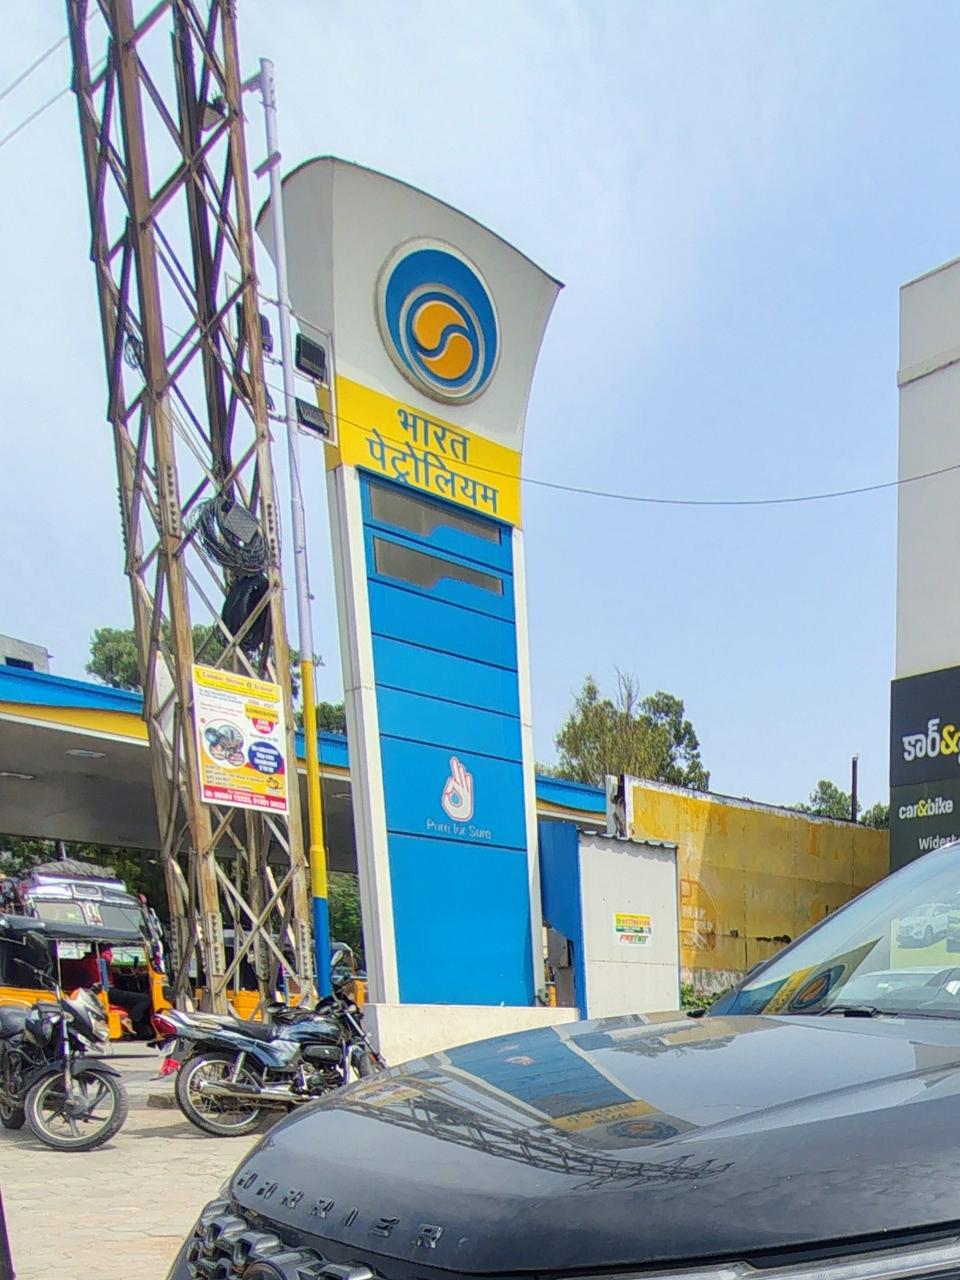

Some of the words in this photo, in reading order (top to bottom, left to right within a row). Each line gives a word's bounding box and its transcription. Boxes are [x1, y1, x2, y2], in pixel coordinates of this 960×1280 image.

[397, 408, 470, 463] भारत
[366, 429, 499, 514] पेट्रोलियम
[899, 797, 954, 819] car&bike
[468, 824, 492, 840] Sure
